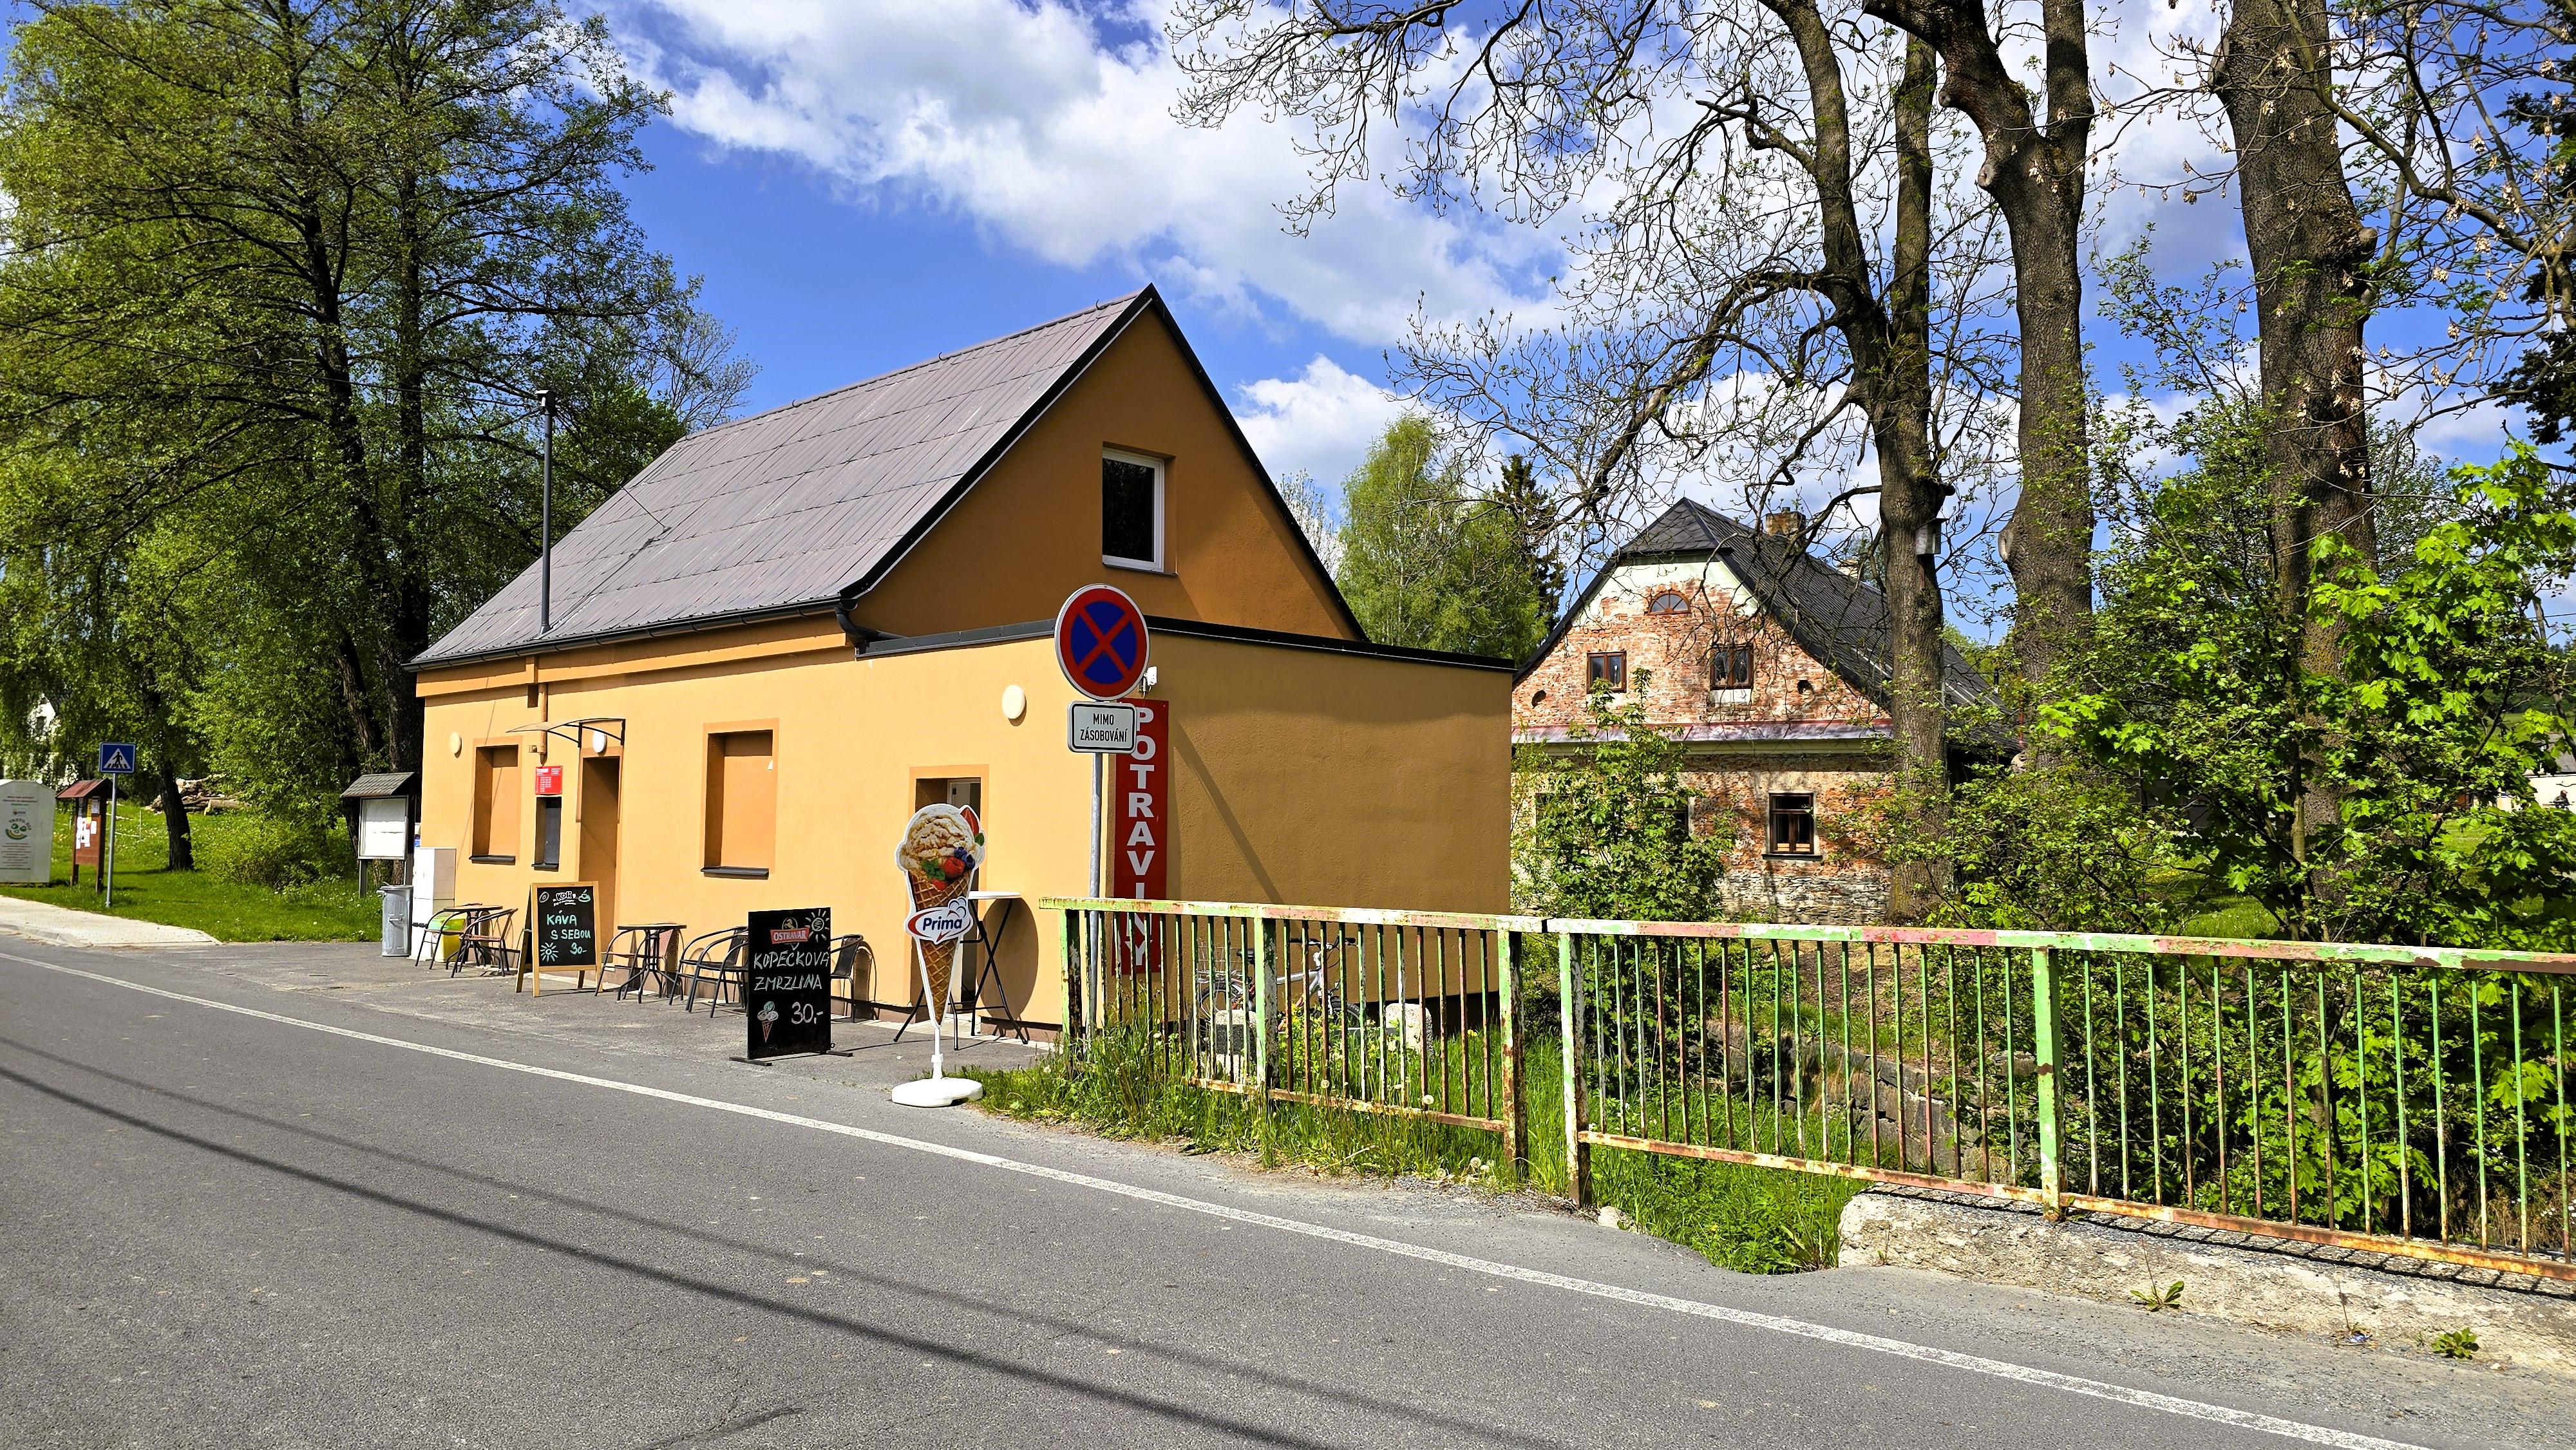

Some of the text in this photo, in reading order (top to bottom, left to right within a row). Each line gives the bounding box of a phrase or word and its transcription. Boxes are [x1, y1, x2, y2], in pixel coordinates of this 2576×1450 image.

[1093, 713, 1114, 725] MIMO
[1080, 727, 1128, 742] ZÁSOBOVÁNÍ
[547, 910, 577, 927] KÁVA
[922, 916, 963, 931] Prima
[551, 928, 591, 940] S SEBOU
[773, 930, 806, 941] OSTRAVAR
[754, 974, 822, 991] ZMRZLINA
